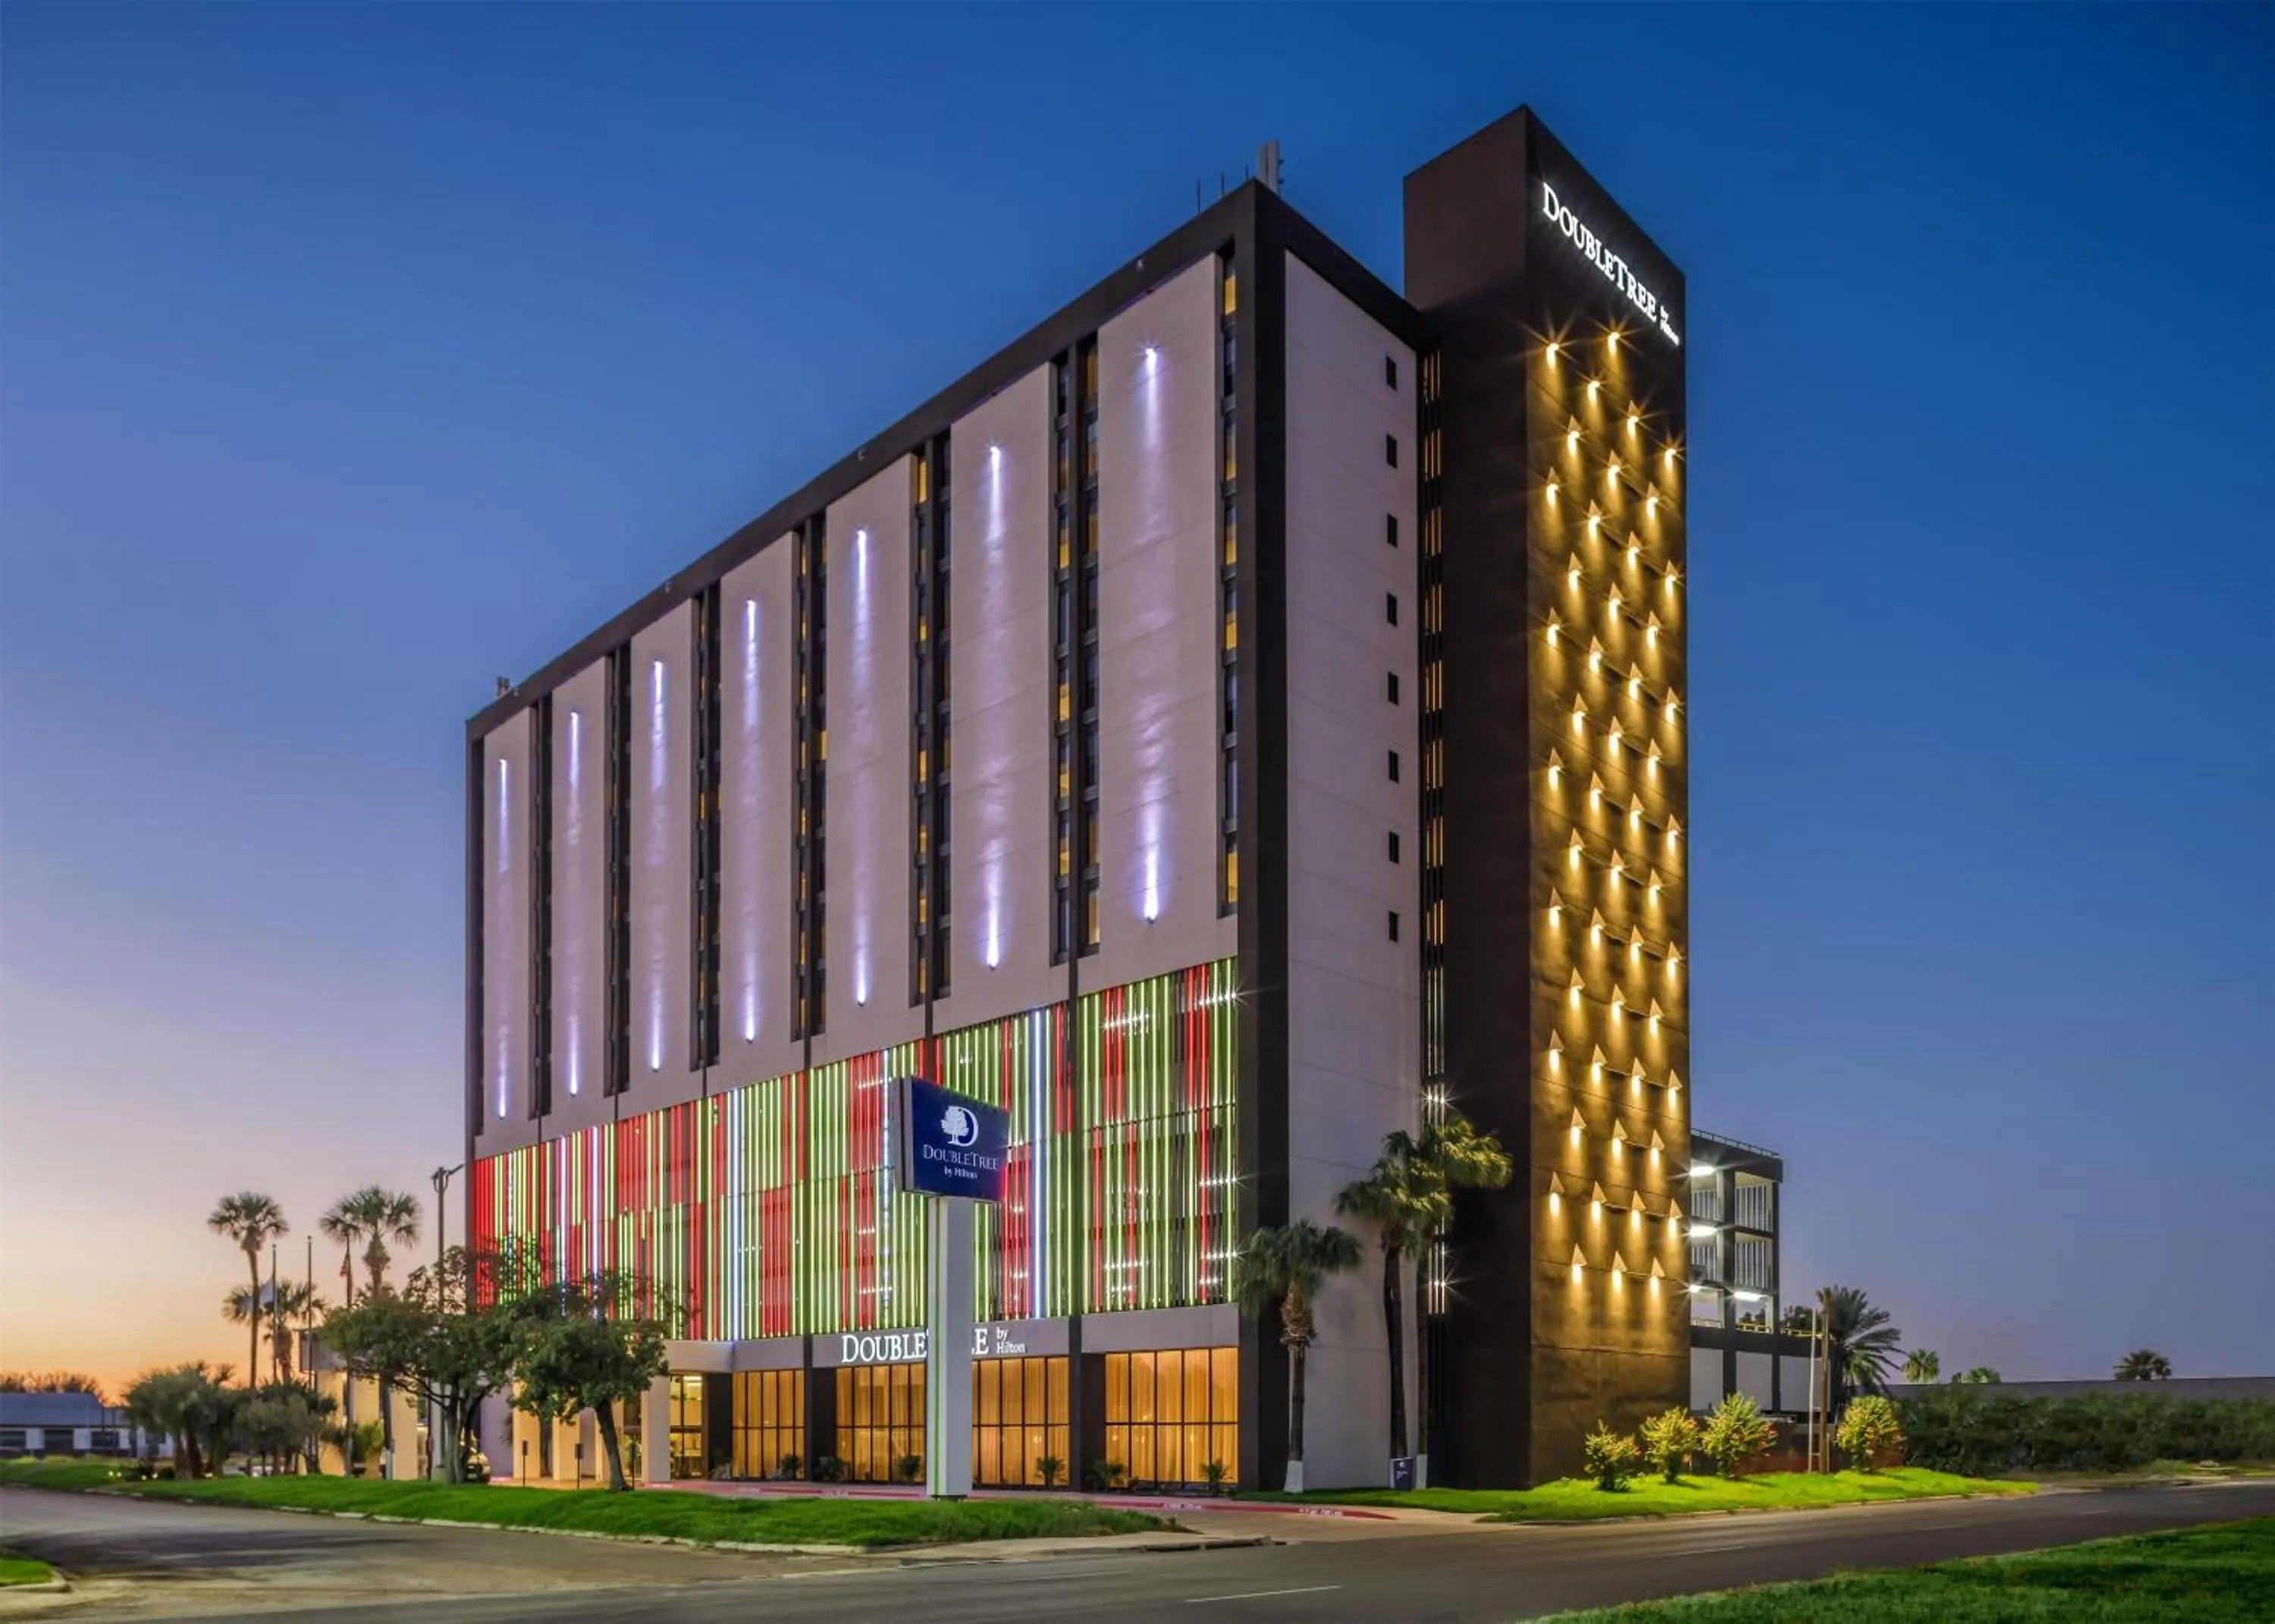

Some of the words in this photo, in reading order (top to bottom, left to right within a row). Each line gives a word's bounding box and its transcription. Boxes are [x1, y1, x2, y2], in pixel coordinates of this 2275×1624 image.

[1542, 181, 1657, 323] DOUBLETREE
[923, 1144, 999, 1170] DOUBLETREE
[842, 1328, 989, 1363] DOUBLEE
[996, 1326, 1009, 1341] by
[996, 1341, 1025, 1354] Hilton
